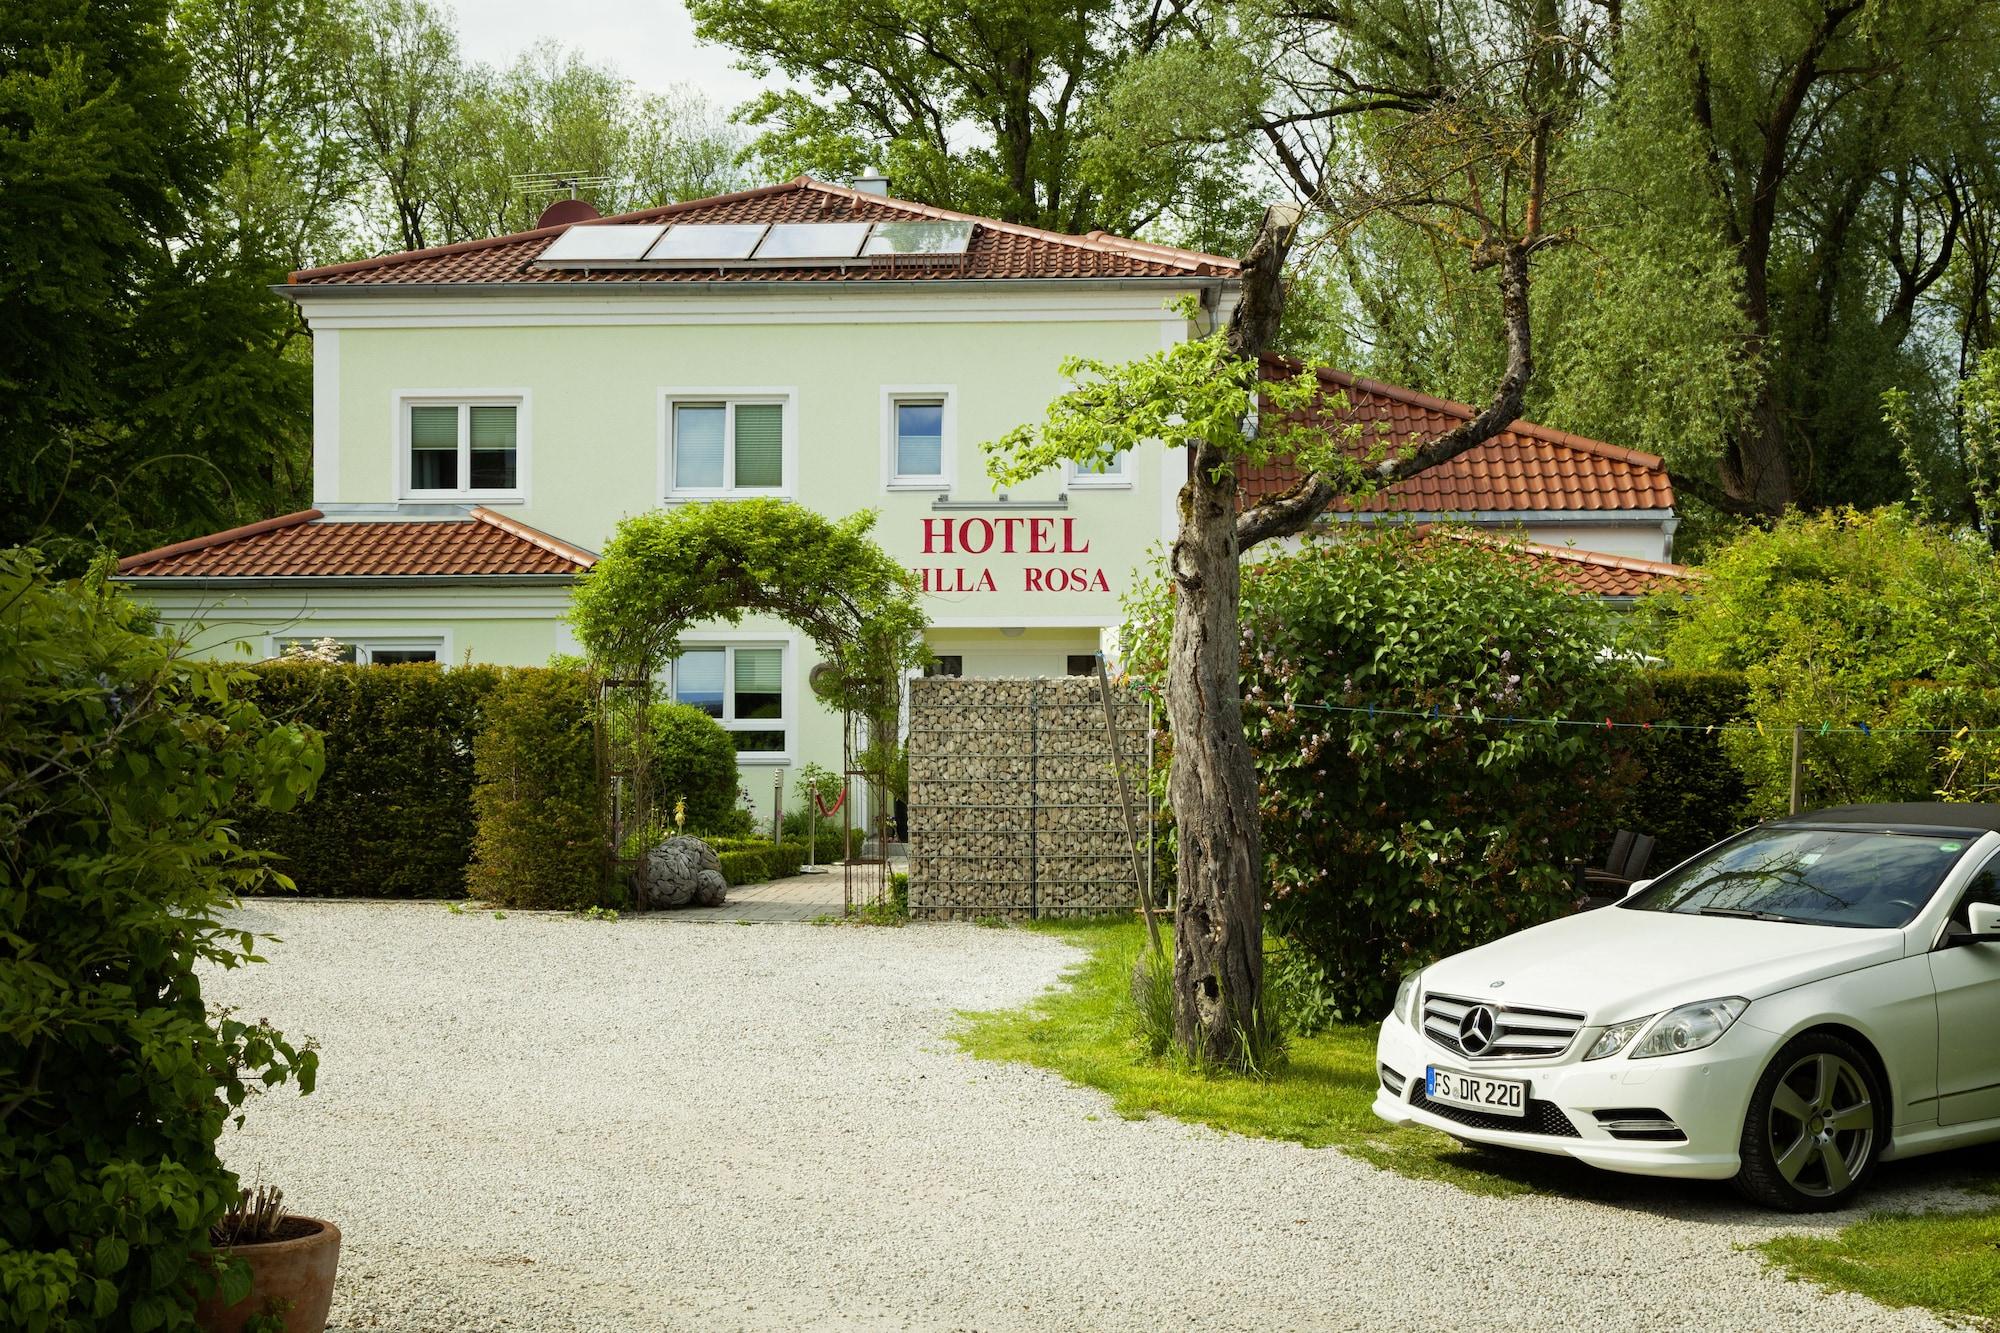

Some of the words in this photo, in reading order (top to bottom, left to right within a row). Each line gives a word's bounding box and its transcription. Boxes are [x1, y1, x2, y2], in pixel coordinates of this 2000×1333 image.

[920, 517, 1090, 554] HOTEL
[911, 567, 998, 592] ILLA
[1023, 567, 1110, 592] ROSA
[1434, 1072, 1451, 1096] FS
[1459, 1078, 1481, 1103] DR
[1485, 1082, 1521, 1108] 220
